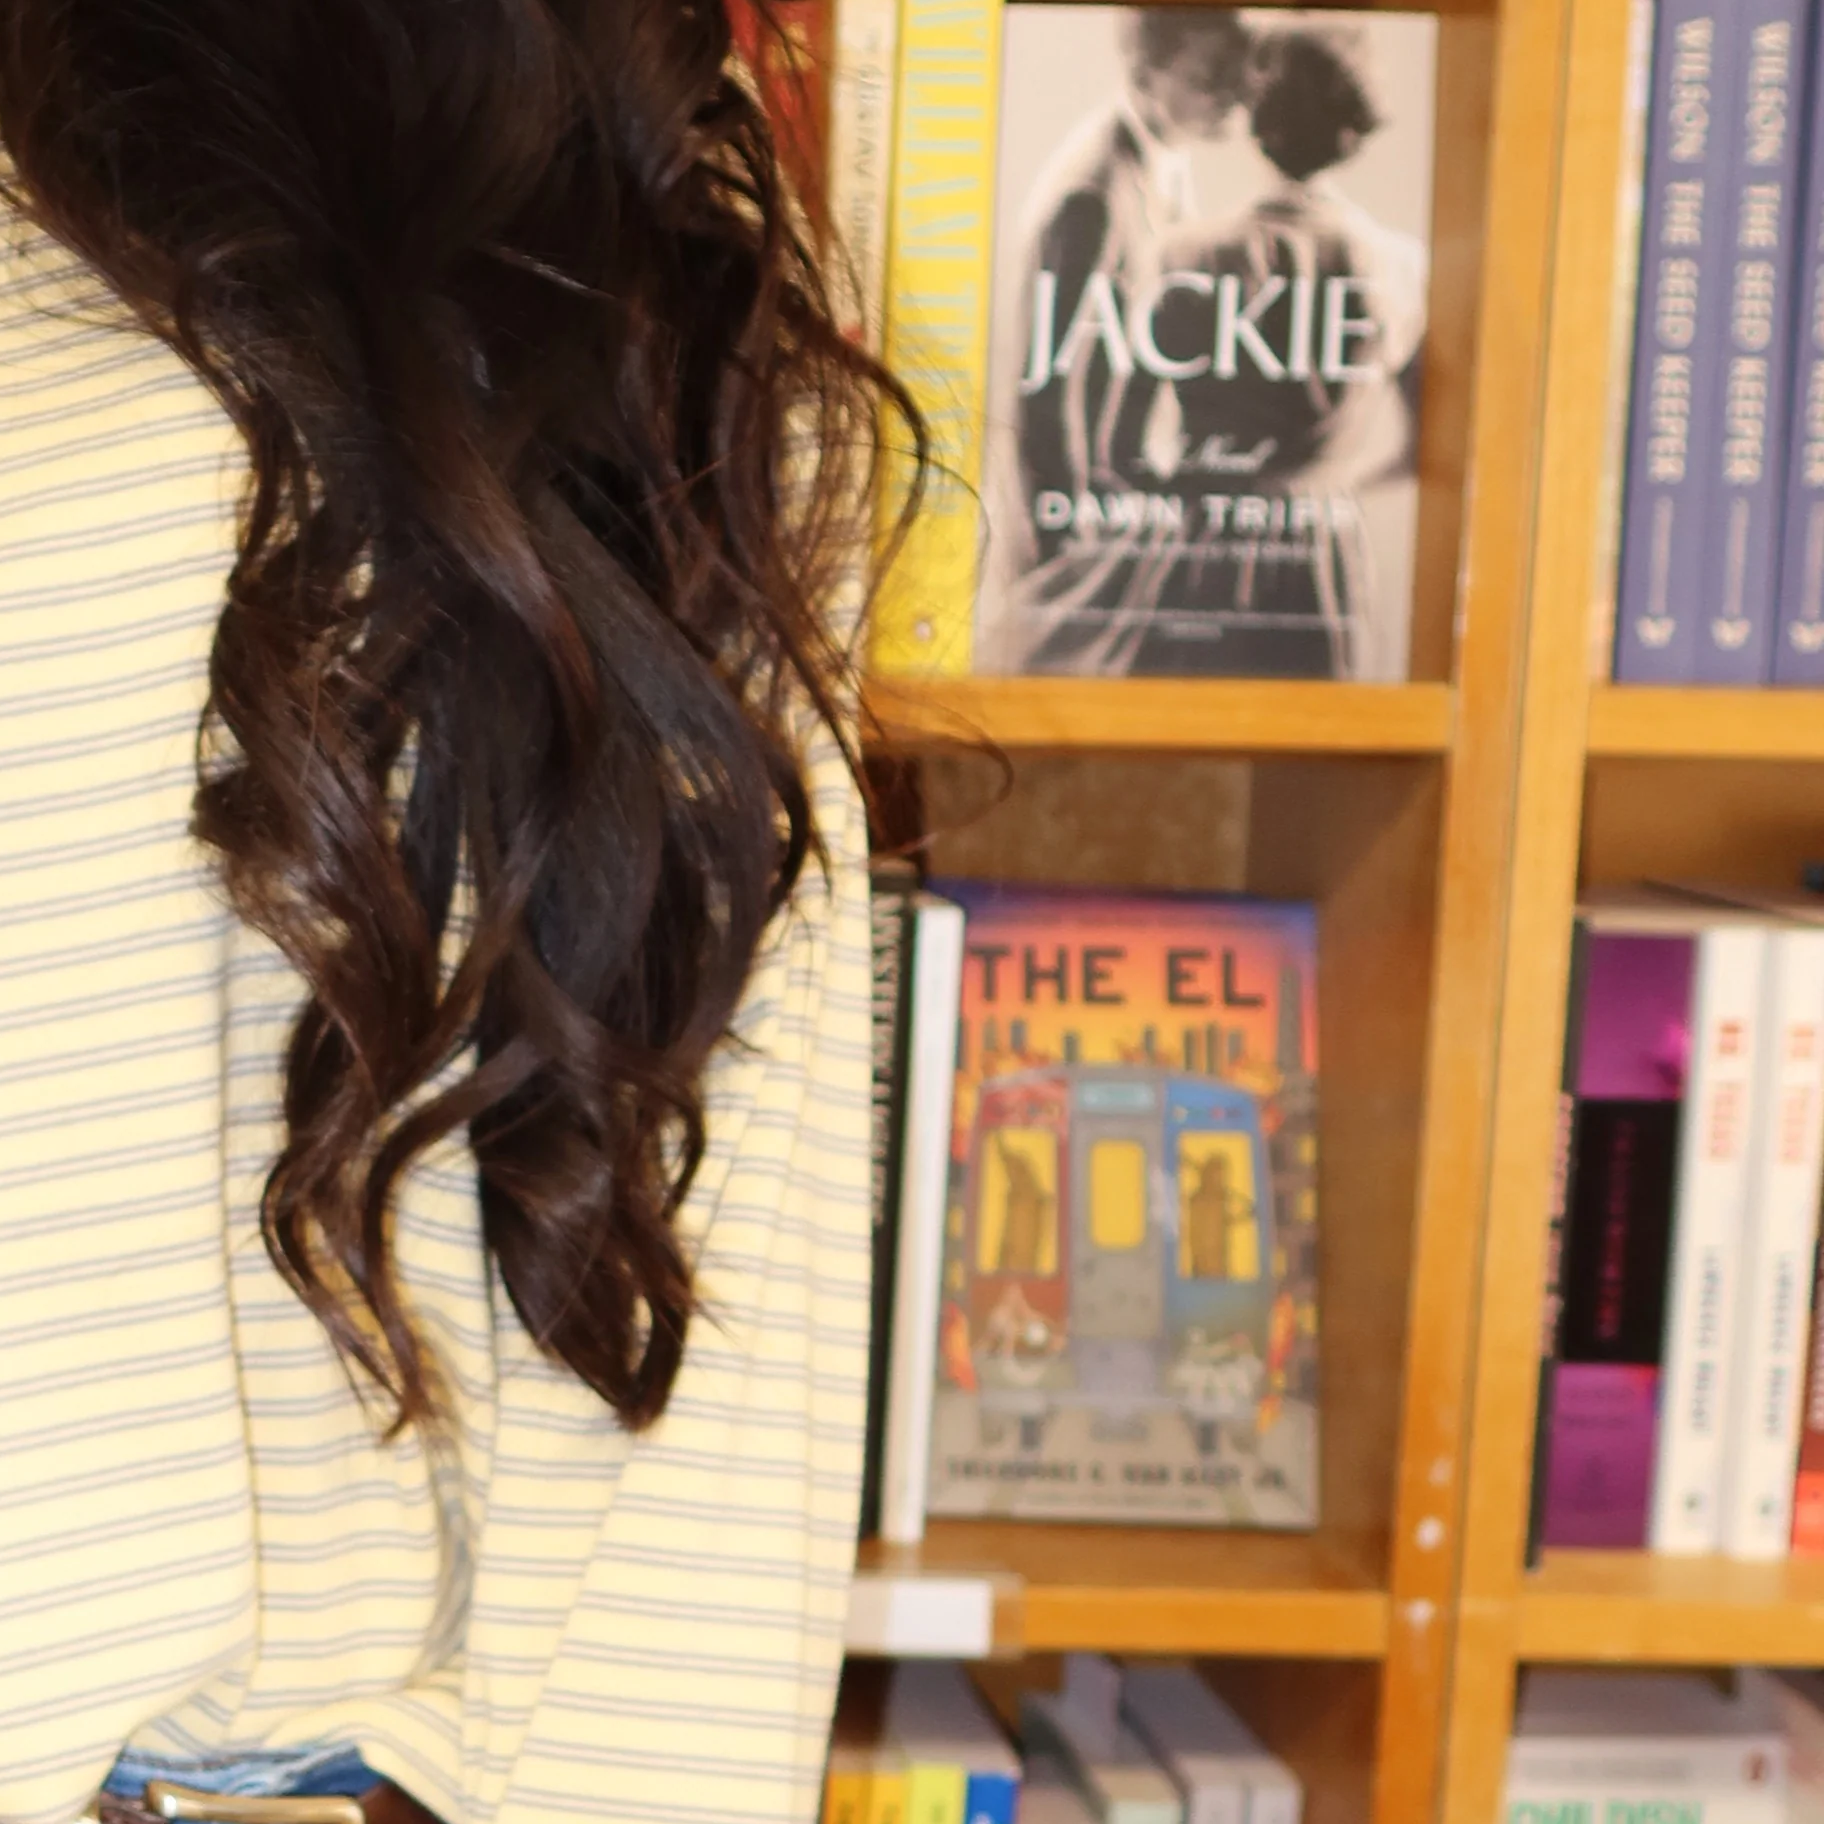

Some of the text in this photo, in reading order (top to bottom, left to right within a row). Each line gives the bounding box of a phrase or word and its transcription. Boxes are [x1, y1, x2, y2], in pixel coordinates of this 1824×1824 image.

[1646, 17, 1715, 484] WILSON THE SEED KEEPER
[1721, 21, 1792, 484] WILSON THE SEED KEEPER
[1017, 270, 1385, 392] JACKIE
[1036, 489, 1185, 532] DAWN
[966, 944, 1267, 1011] THE EL
